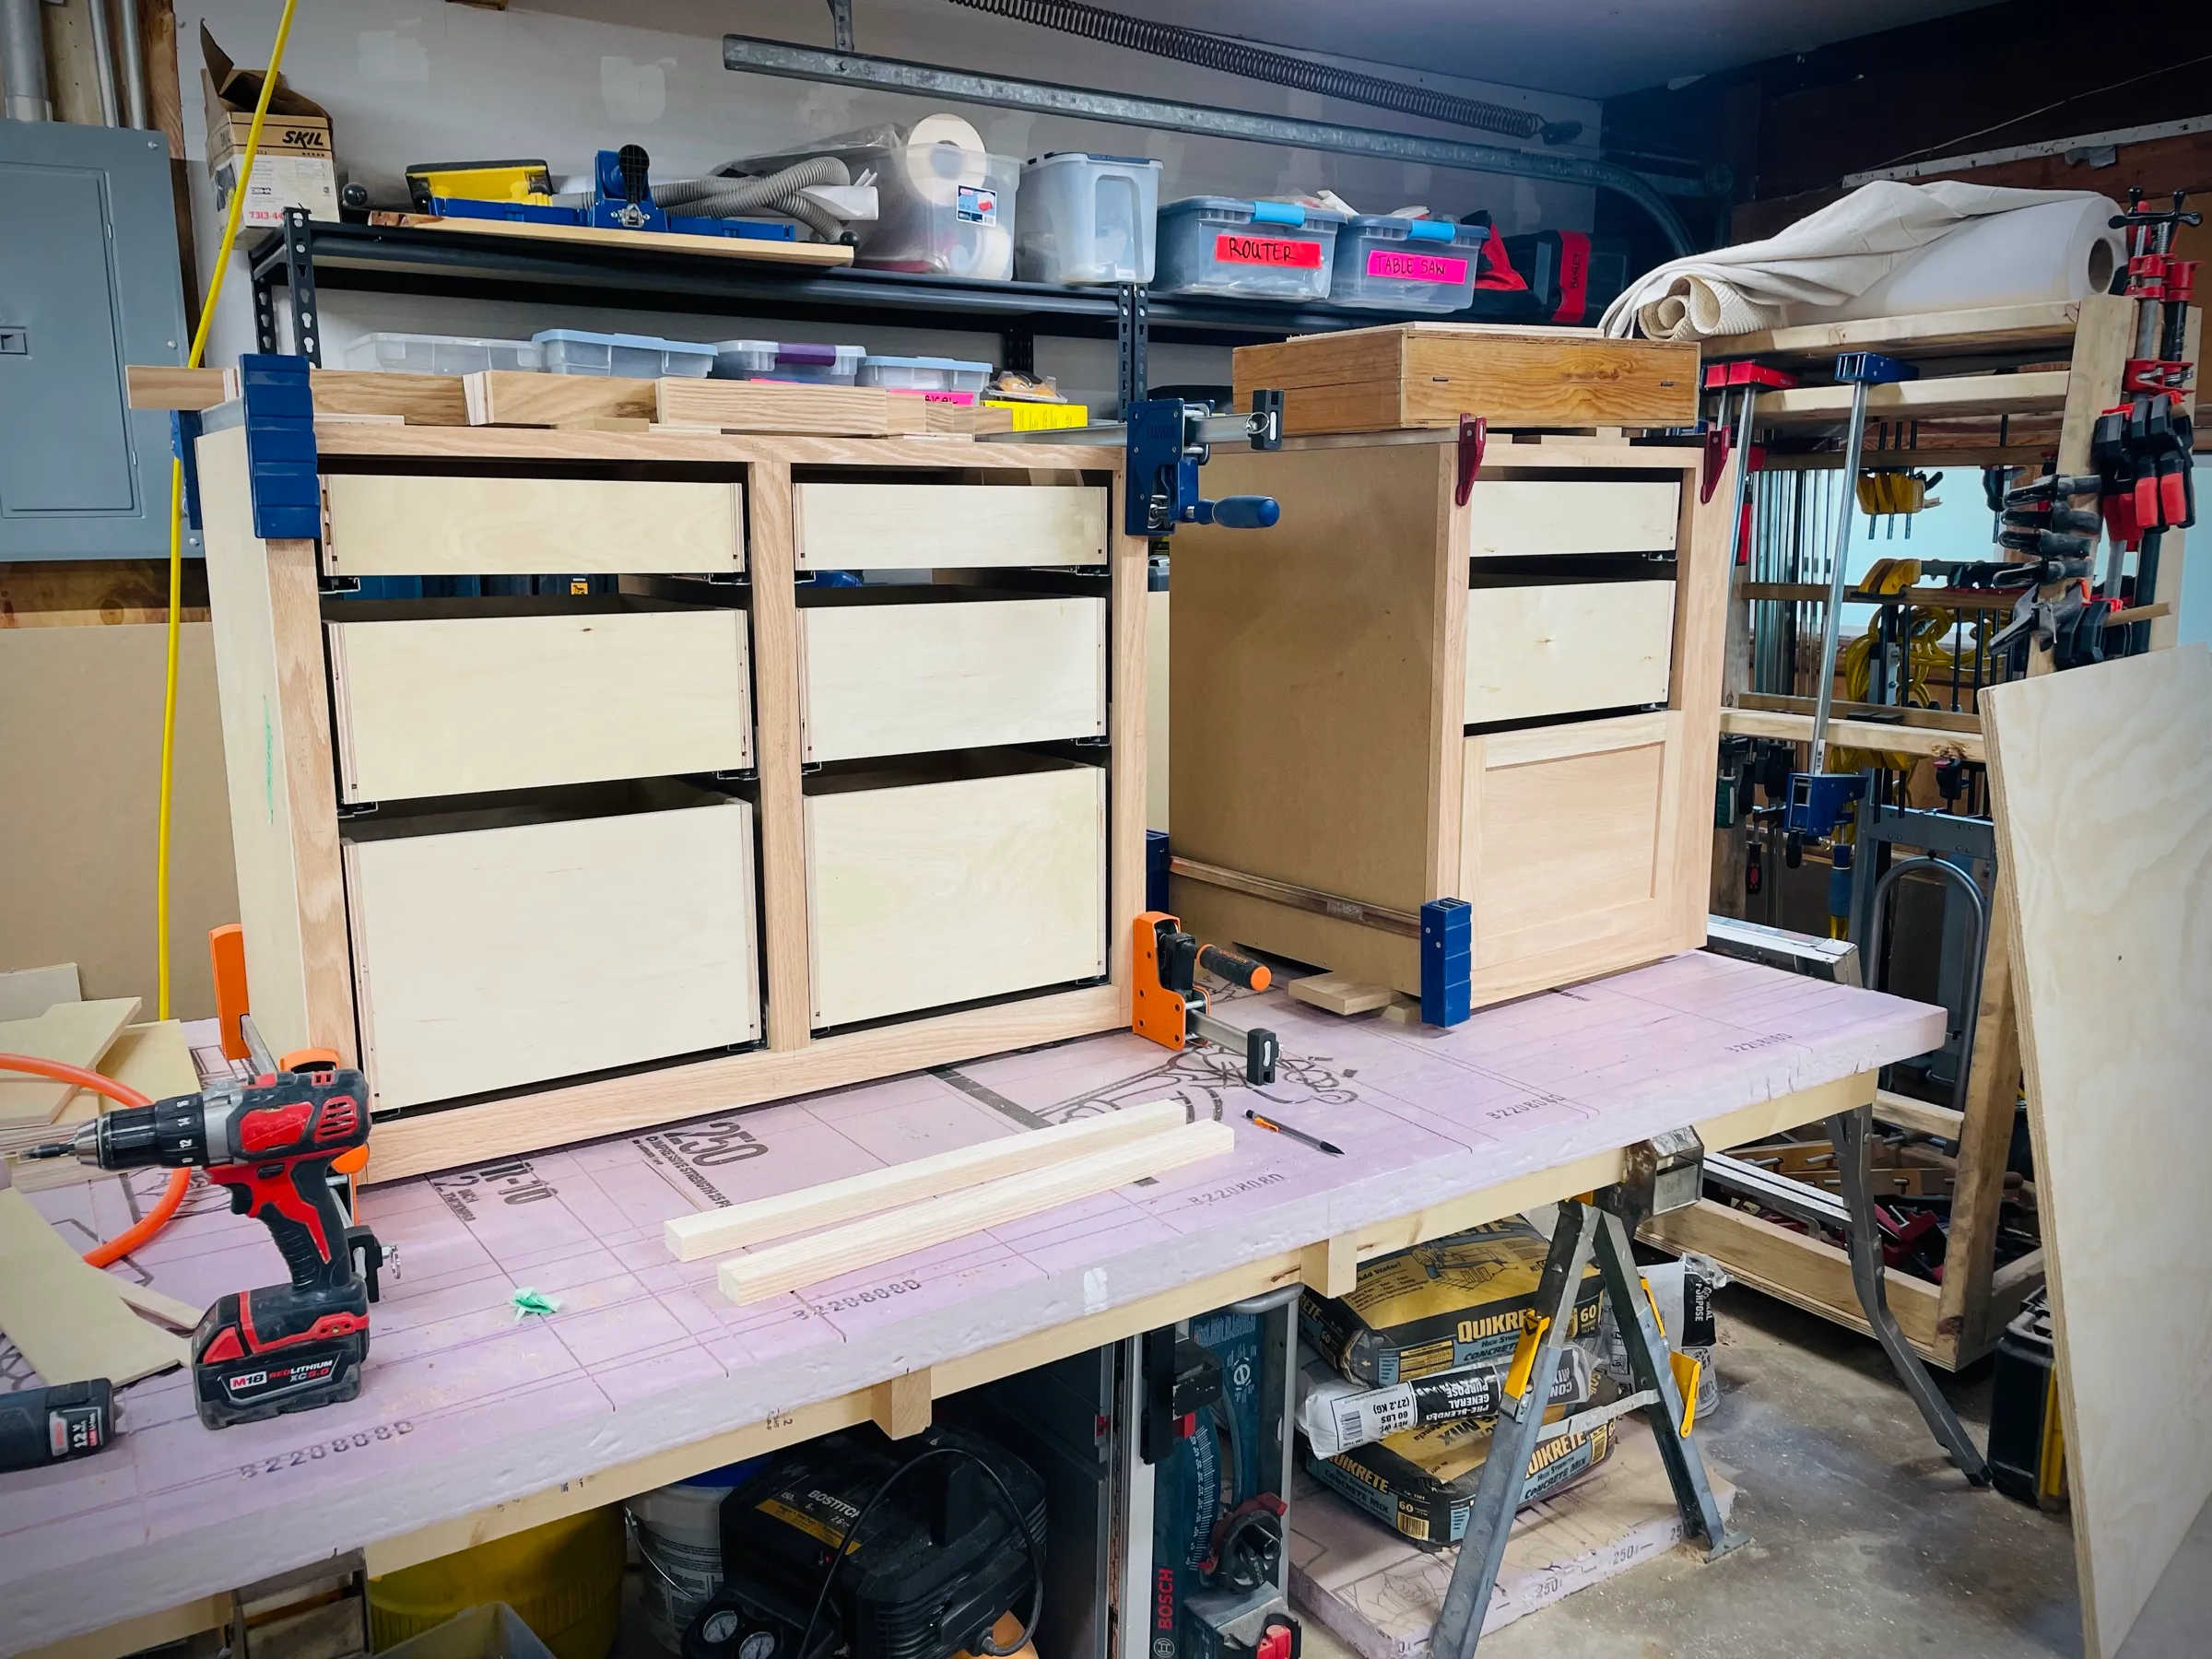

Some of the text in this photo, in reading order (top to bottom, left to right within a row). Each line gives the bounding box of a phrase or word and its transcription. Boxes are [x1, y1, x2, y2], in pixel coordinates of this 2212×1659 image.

[282, 130, 324, 149] SKIL
[1229, 237, 1297, 262] ROUTER
[1375, 254, 1446, 276] TABLE SAW
[177, 1116, 191, 1127] 14
[179, 1138, 193, 1148] 12
[663, 1122, 769, 1167] 250
[681, 1165, 716, 1197] STRENGTH
[1373, 1261, 1402, 1277] Water!
[1580, 1304, 1596, 1324] 60
[1464, 1343, 1516, 1361] CONCRET
[232, 1373, 265, 1388] M18
[1446, 1376, 1489, 1398] PURPOSE
[1373, 1403, 1388, 1415] KG)
[1390, 1396, 1410, 1410] (27.2
[1448, 1394, 1489, 1409] GENERAL
[1381, 1410, 1408, 1424] 60 LBS
[1525, 1430, 1587, 1479] UIKRETE
[1524, 1457, 1587, 1500] CONCRETE MIX
[1369, 1495, 1390, 1514] MIX
[1398, 1500, 1415, 1514] 60
[1613, 1545, 1634, 1565] 250
[1158, 1568, 1174, 1630] BOSCH
